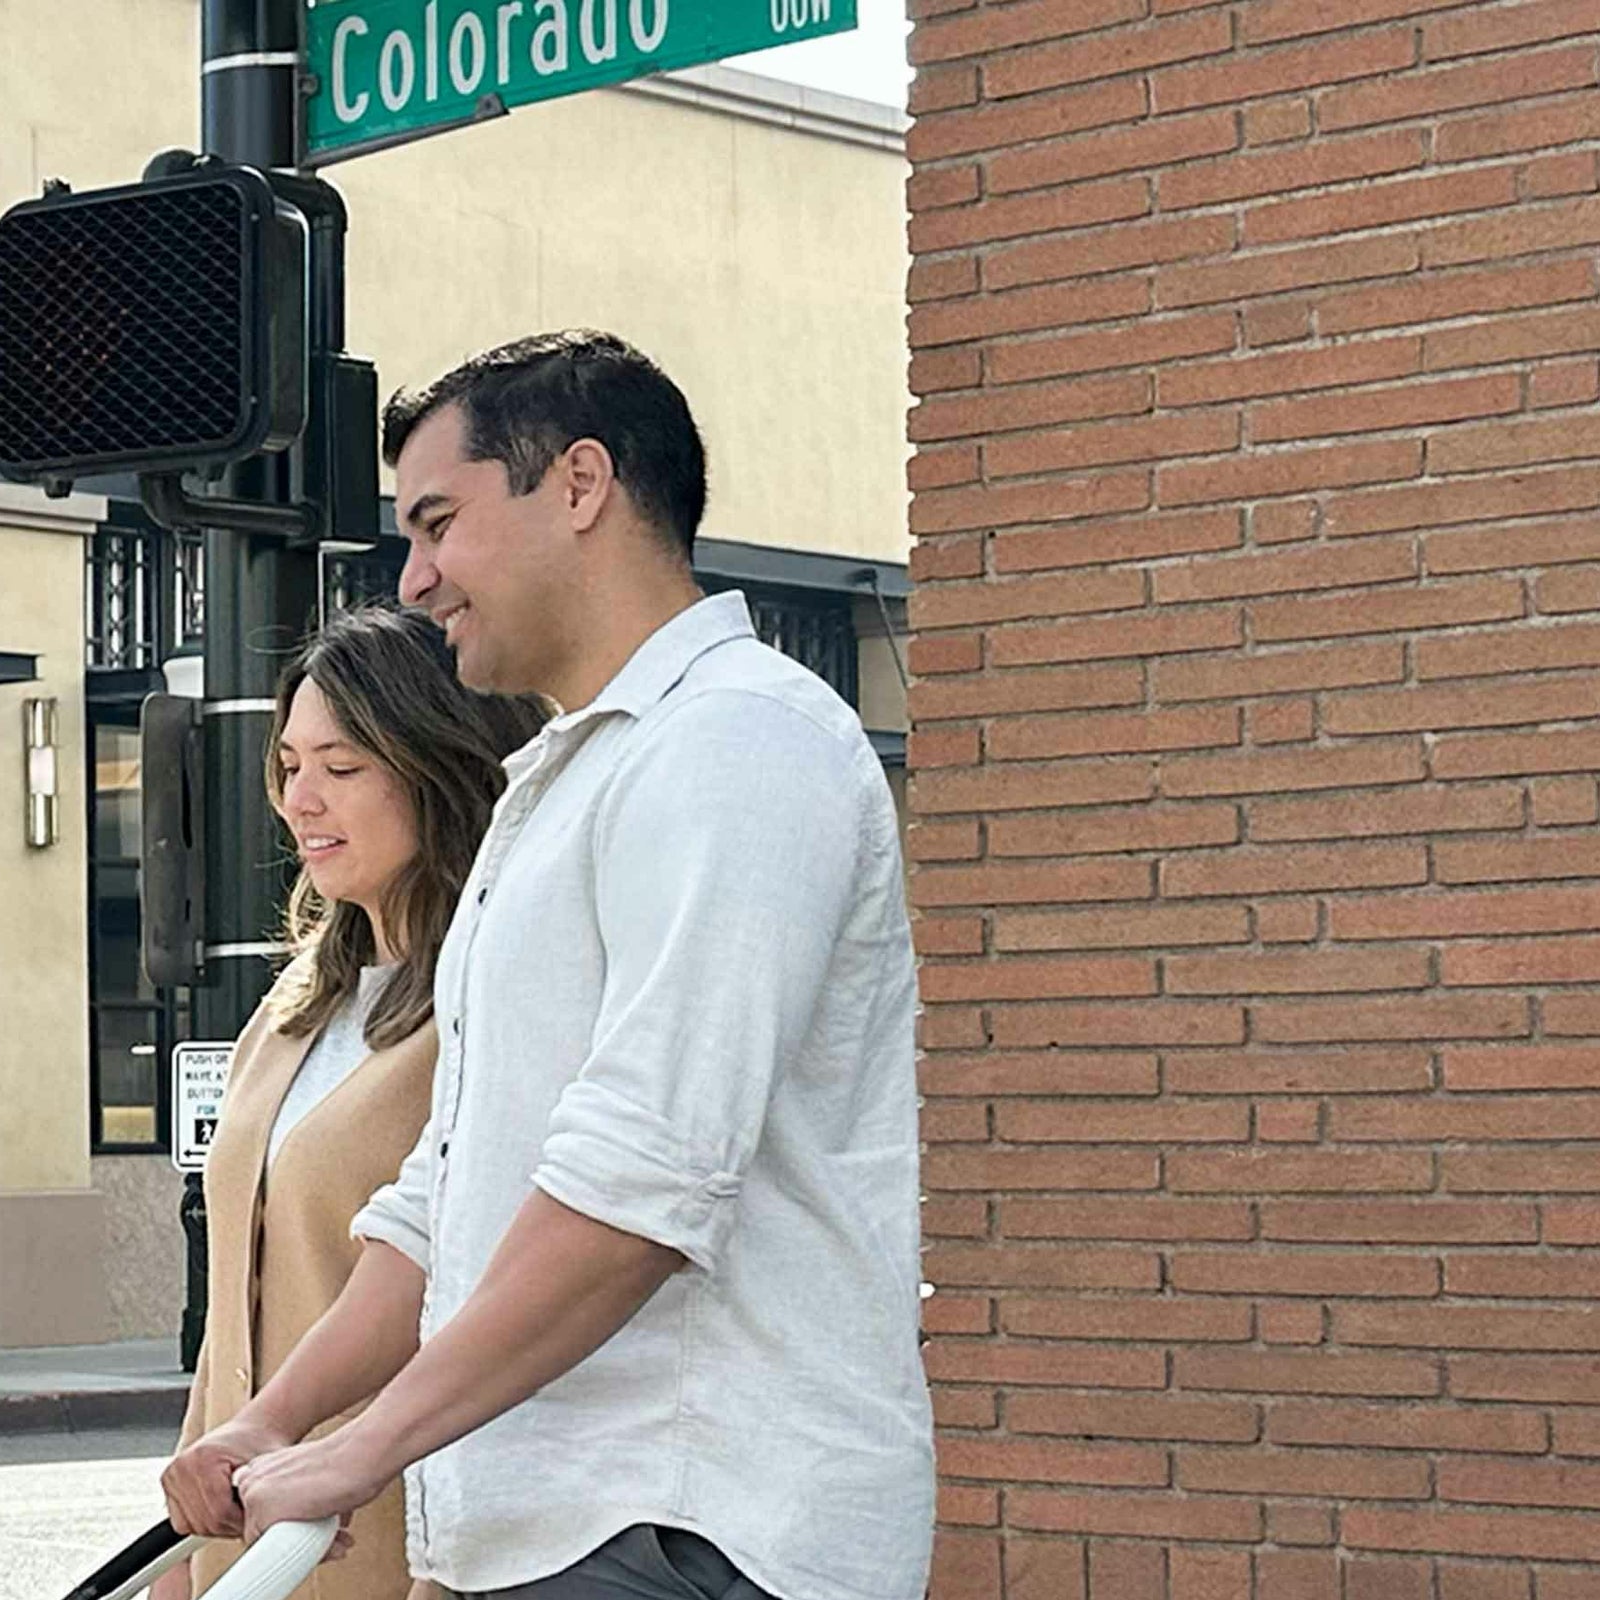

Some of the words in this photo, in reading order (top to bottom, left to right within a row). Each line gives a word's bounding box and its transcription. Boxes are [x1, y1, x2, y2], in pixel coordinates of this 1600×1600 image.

[332, 0, 669, 123] Colorado
[185, 1054, 212, 1064] PUSH
[214, 1054, 229, 1065] OR
[185, 1071, 212, 1081] WAVE
[187, 1087, 224, 1099] BUTTO
[196, 1105, 217, 1115] FOR
